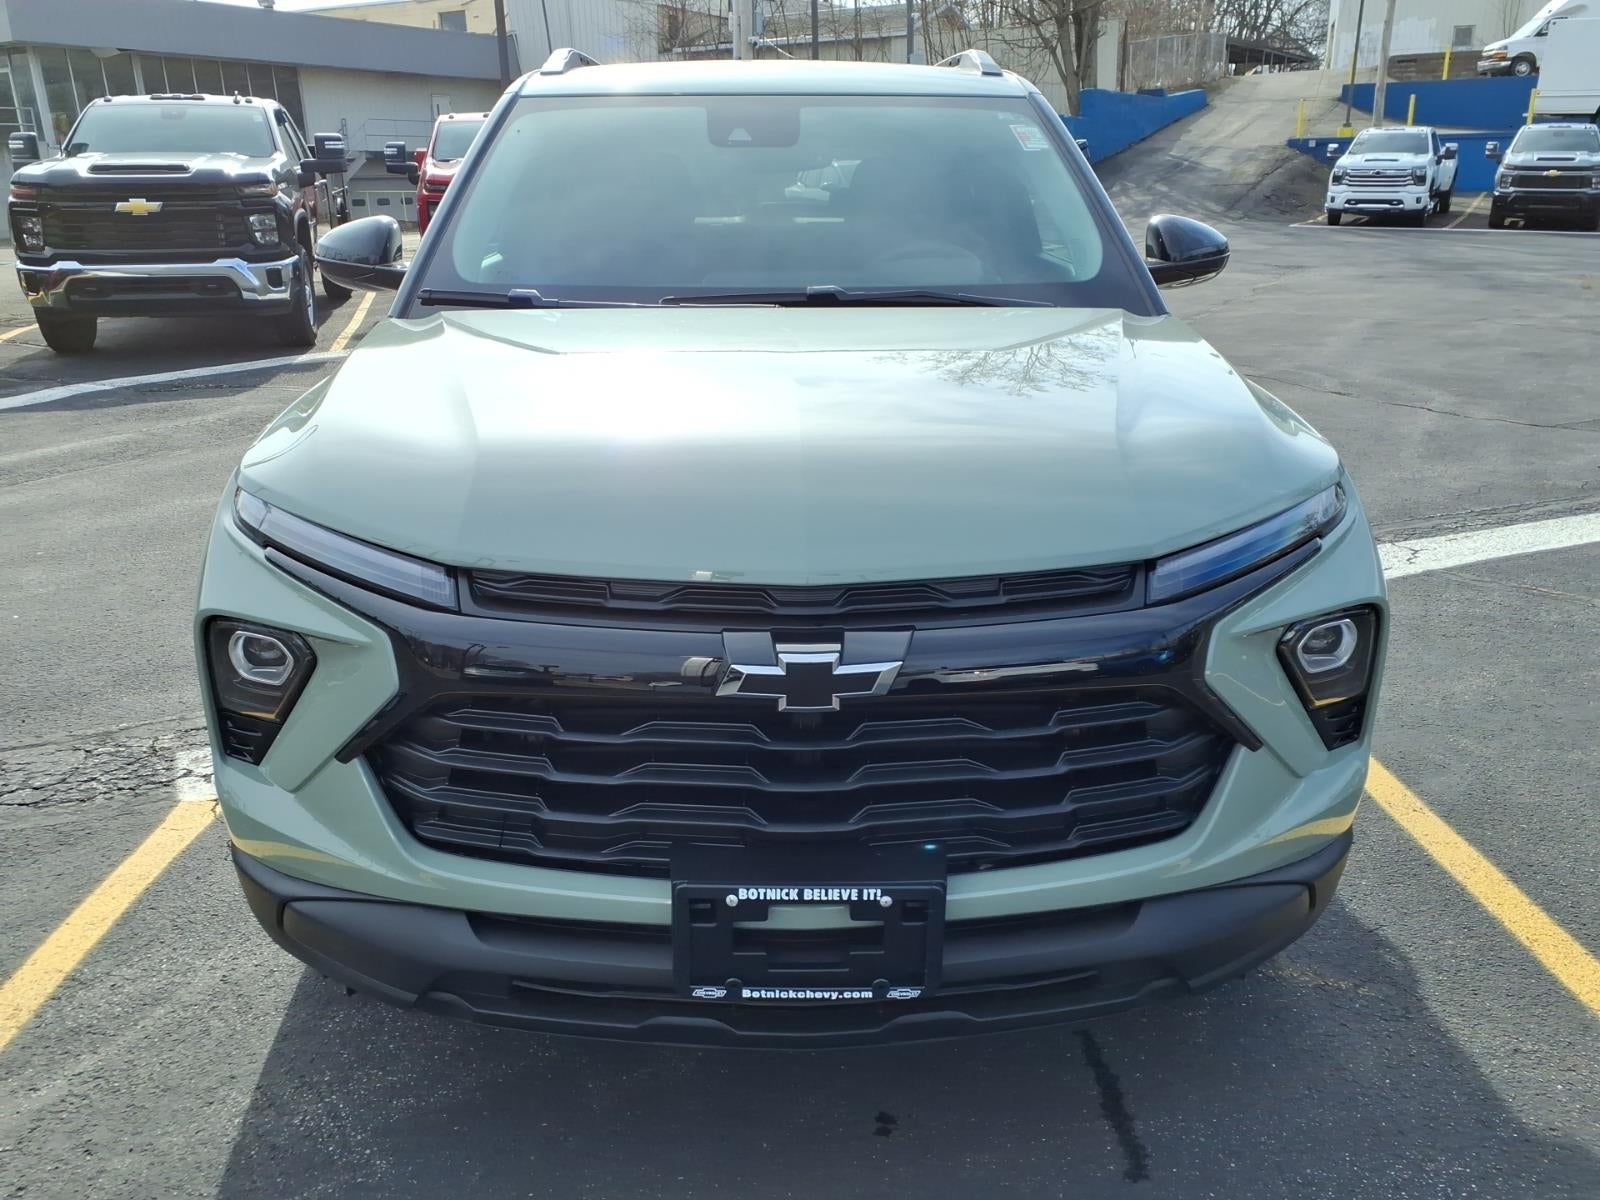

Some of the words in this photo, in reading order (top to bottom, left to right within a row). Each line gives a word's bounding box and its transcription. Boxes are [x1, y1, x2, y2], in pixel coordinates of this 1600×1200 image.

[739, 888, 799, 901] BOTNICK
[804, 888, 860, 901] BELIEVE
[863, 888, 881, 901] IT!
[742, 989, 872, 999] Botnickchevy.com
